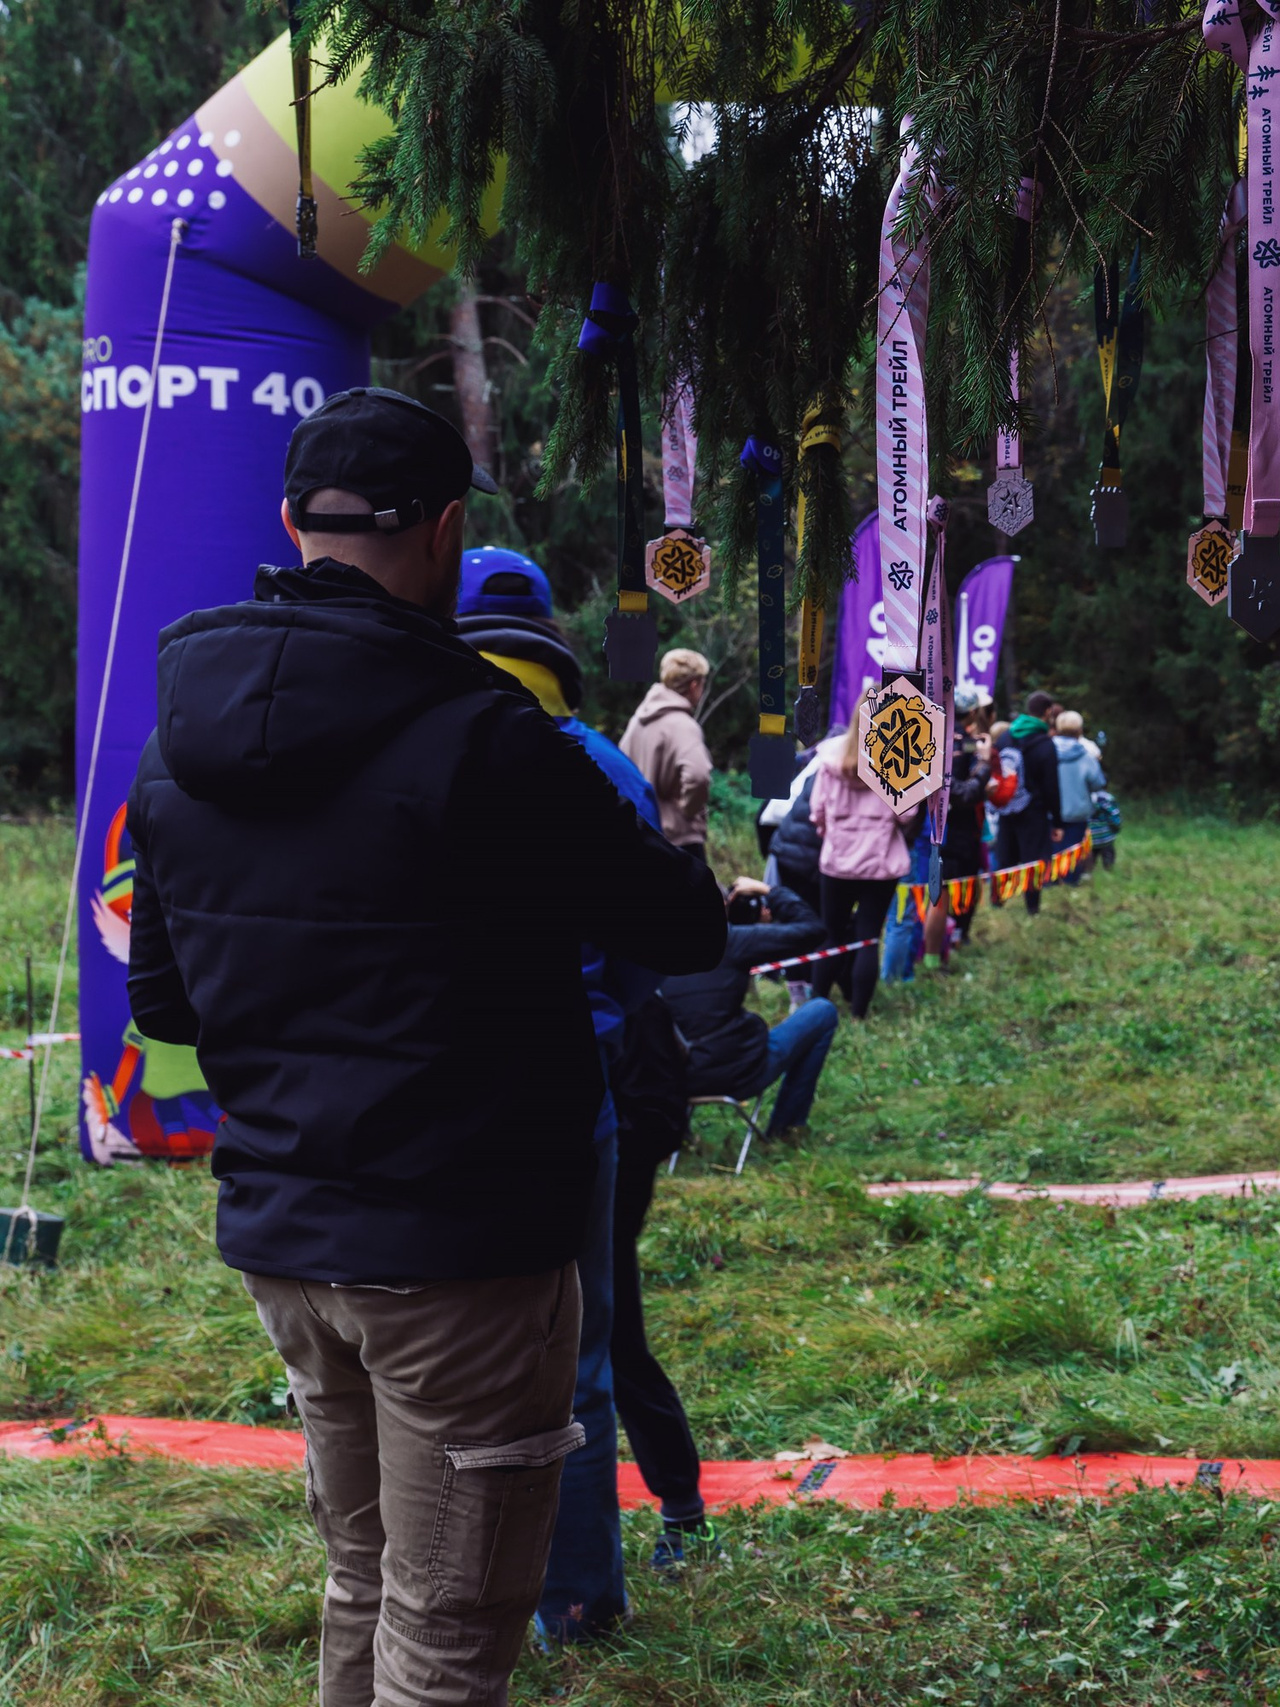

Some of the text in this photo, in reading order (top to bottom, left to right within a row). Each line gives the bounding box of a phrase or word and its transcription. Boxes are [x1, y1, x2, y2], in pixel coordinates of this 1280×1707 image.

[1262, 108, 1275, 225] АТОМНЫЙ ТРЕЙЛ
[81, 364, 325, 419] СПОРТ 40
[1263, 287, 1275, 404] АТОМНЫЙ ТРЕЙЛ
[888, 340, 908, 531] АТОМНЫЙ ТРЕЙЛ
[970, 624, 996, 673] 40
